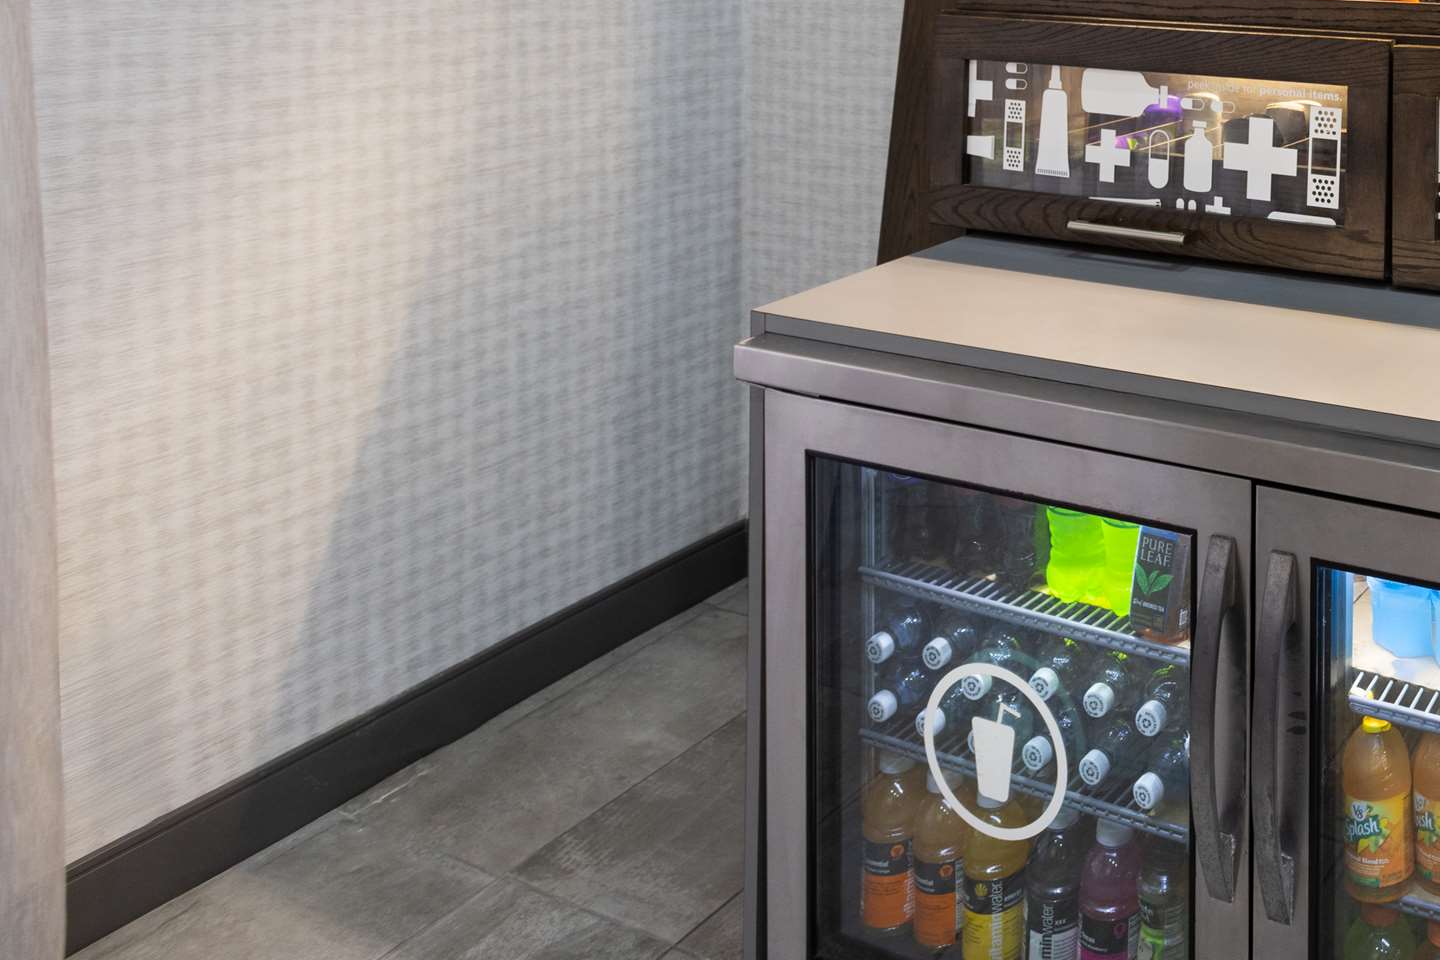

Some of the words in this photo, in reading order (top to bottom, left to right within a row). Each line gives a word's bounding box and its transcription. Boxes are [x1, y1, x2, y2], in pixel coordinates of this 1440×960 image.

[1259, 85, 1306, 99] personal
[1142, 535, 1174, 555] PURE
[1352, 803, 1366, 817] V8
[1040, 904, 1055, 960] minwater
